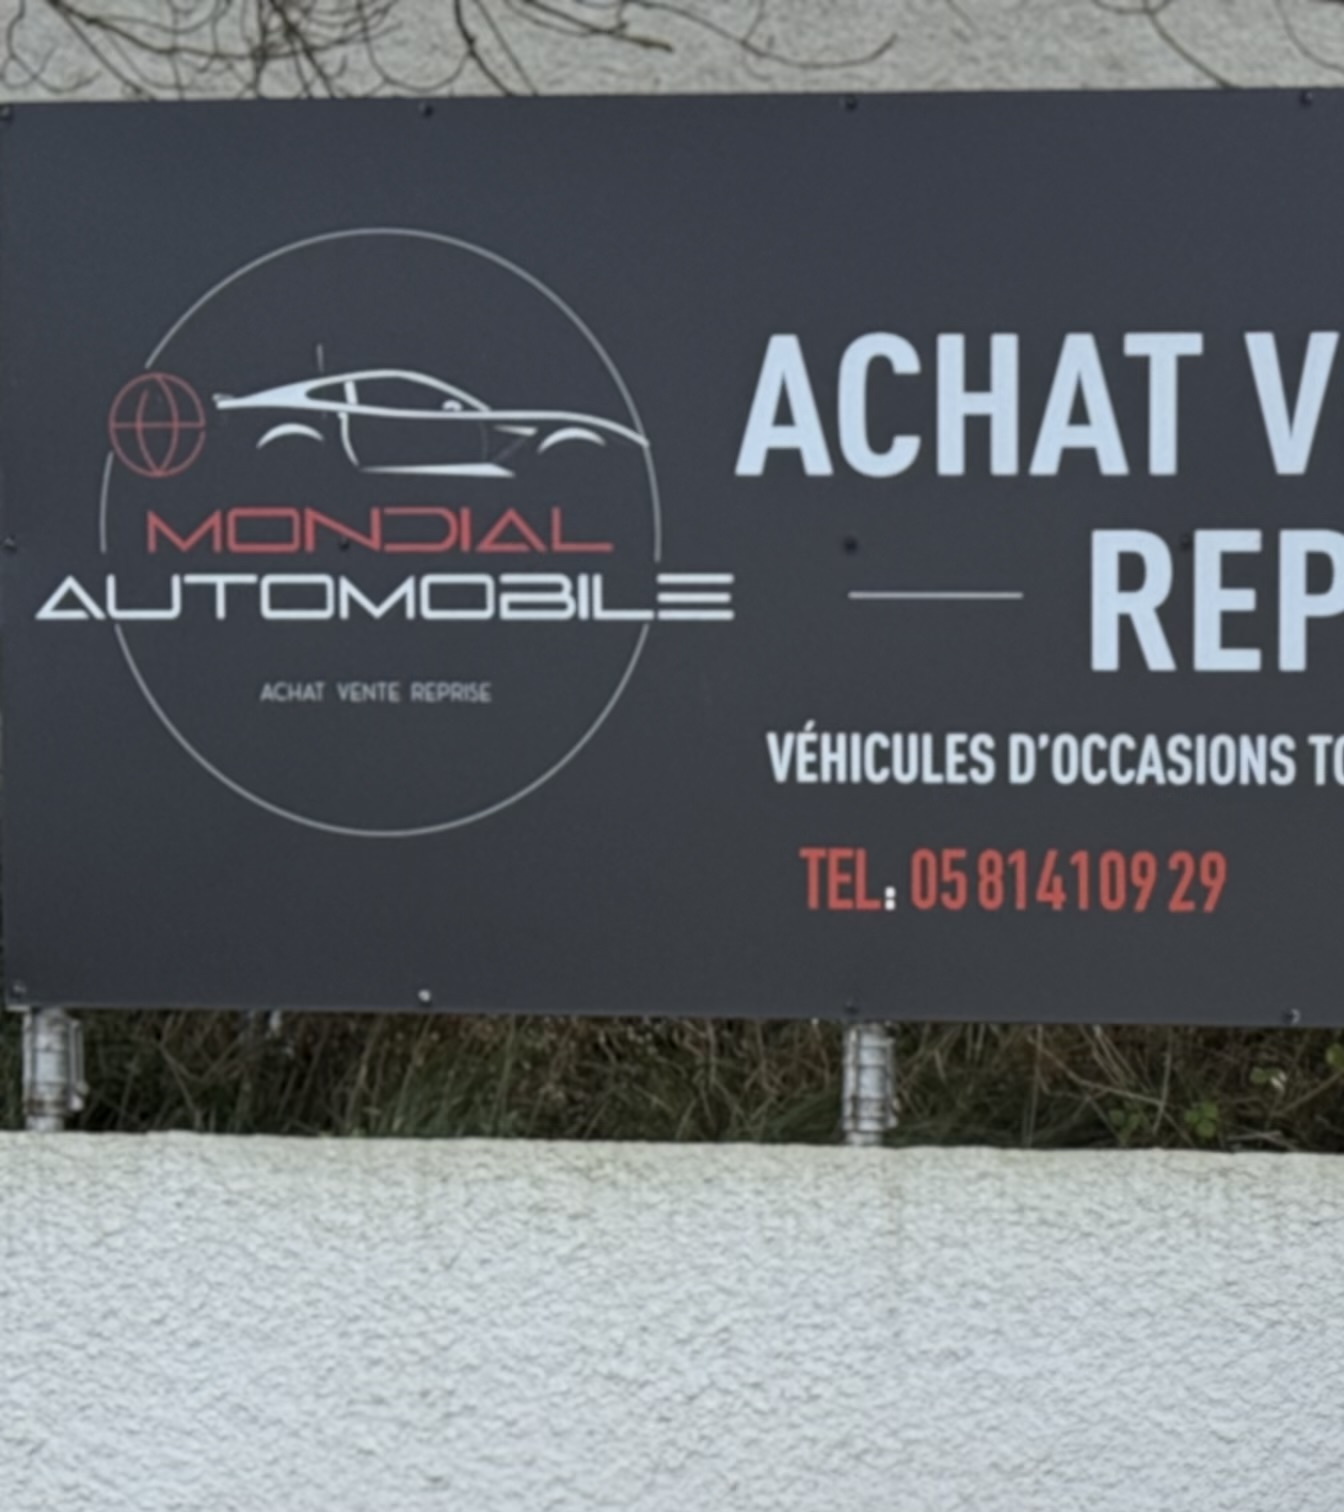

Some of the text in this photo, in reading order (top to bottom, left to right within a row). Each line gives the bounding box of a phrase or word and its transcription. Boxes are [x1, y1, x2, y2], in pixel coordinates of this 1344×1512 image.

[735, 332, 1204, 478] ACHAT
[147, 507, 613, 553] MONDIAL
[36, 573, 734, 621] AUTOMOBILE
[260, 681, 492, 703] ACHAT VENTE REPRISE
[766, 719, 996, 785] VÉHICULES
[1009, 733, 1296, 786] D'OCCASIONS
